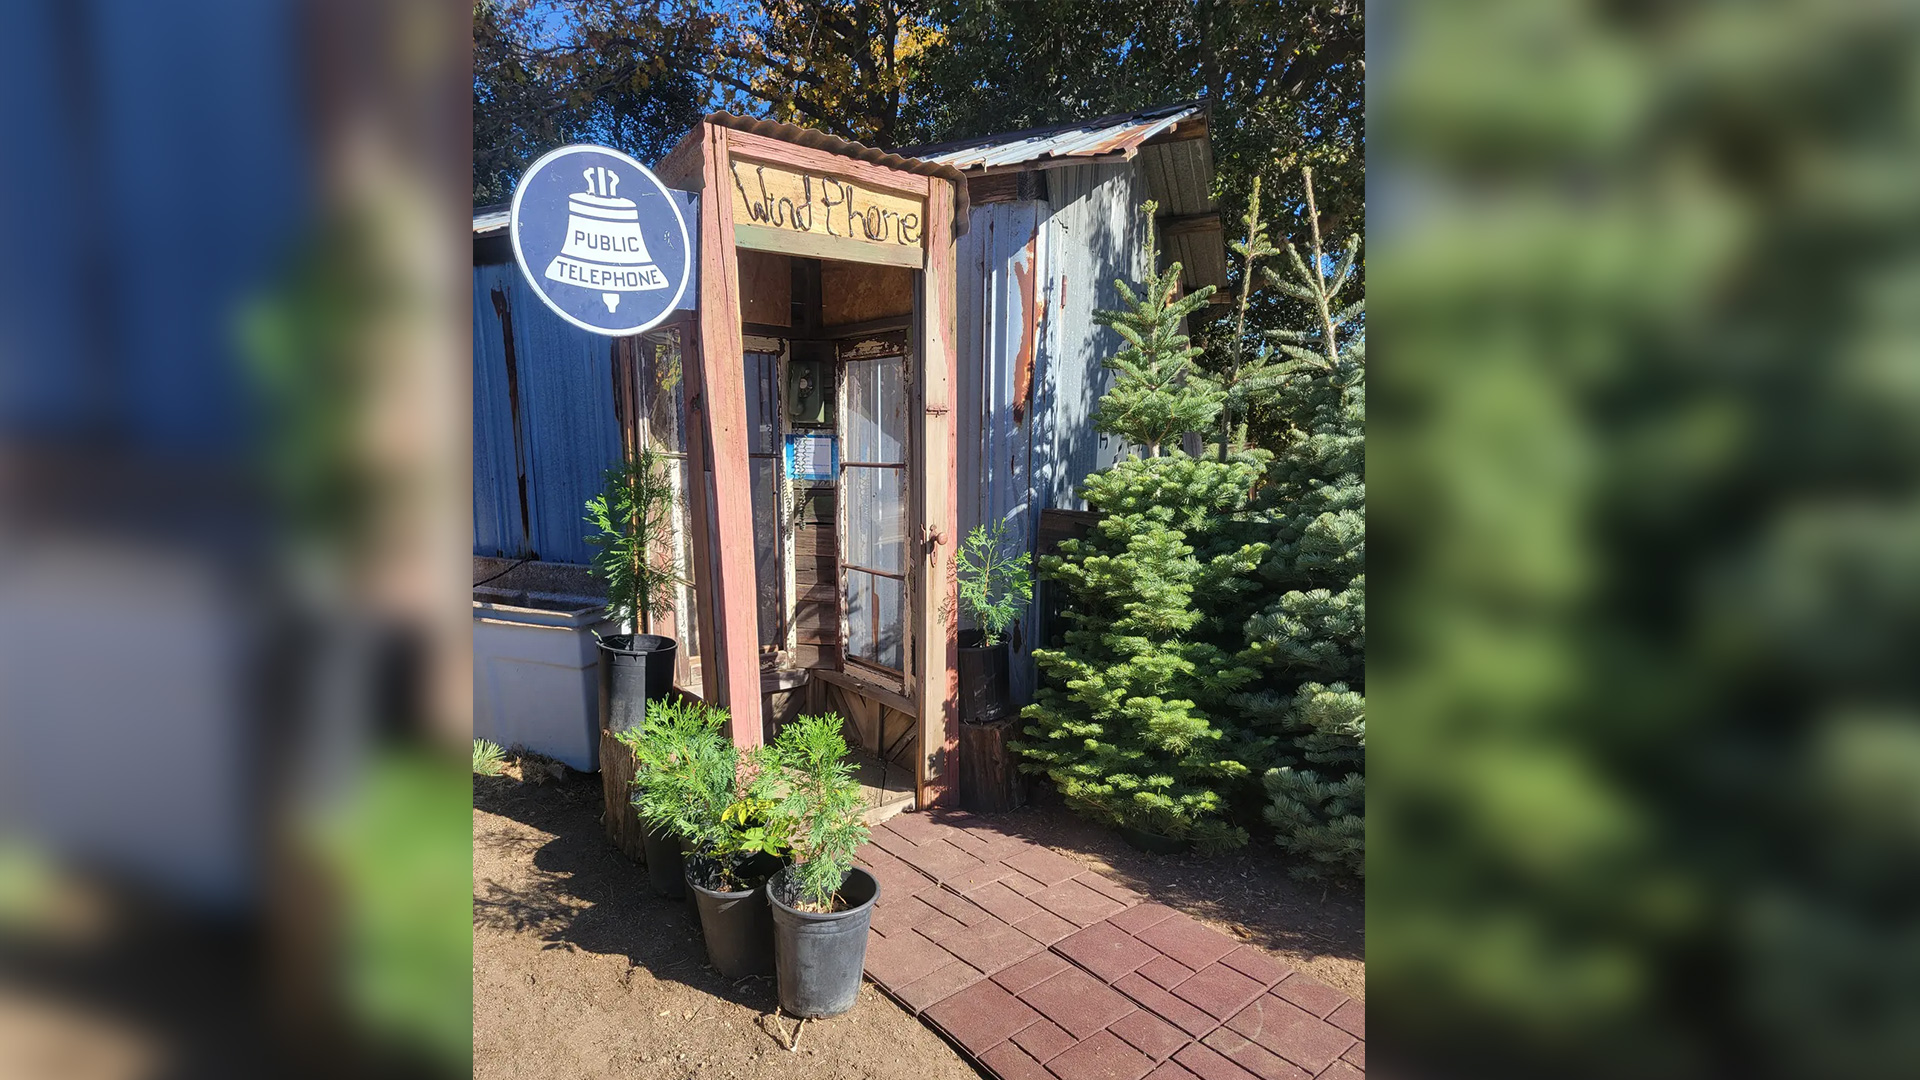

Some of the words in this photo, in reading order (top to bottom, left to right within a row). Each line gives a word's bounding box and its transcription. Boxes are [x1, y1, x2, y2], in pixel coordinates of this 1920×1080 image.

[730, 159, 811, 230] Wind
[821, 175, 923, 244] Phone
[574, 230, 640, 253] PUBLIC
[556, 260, 661, 287] TELEPHONE
